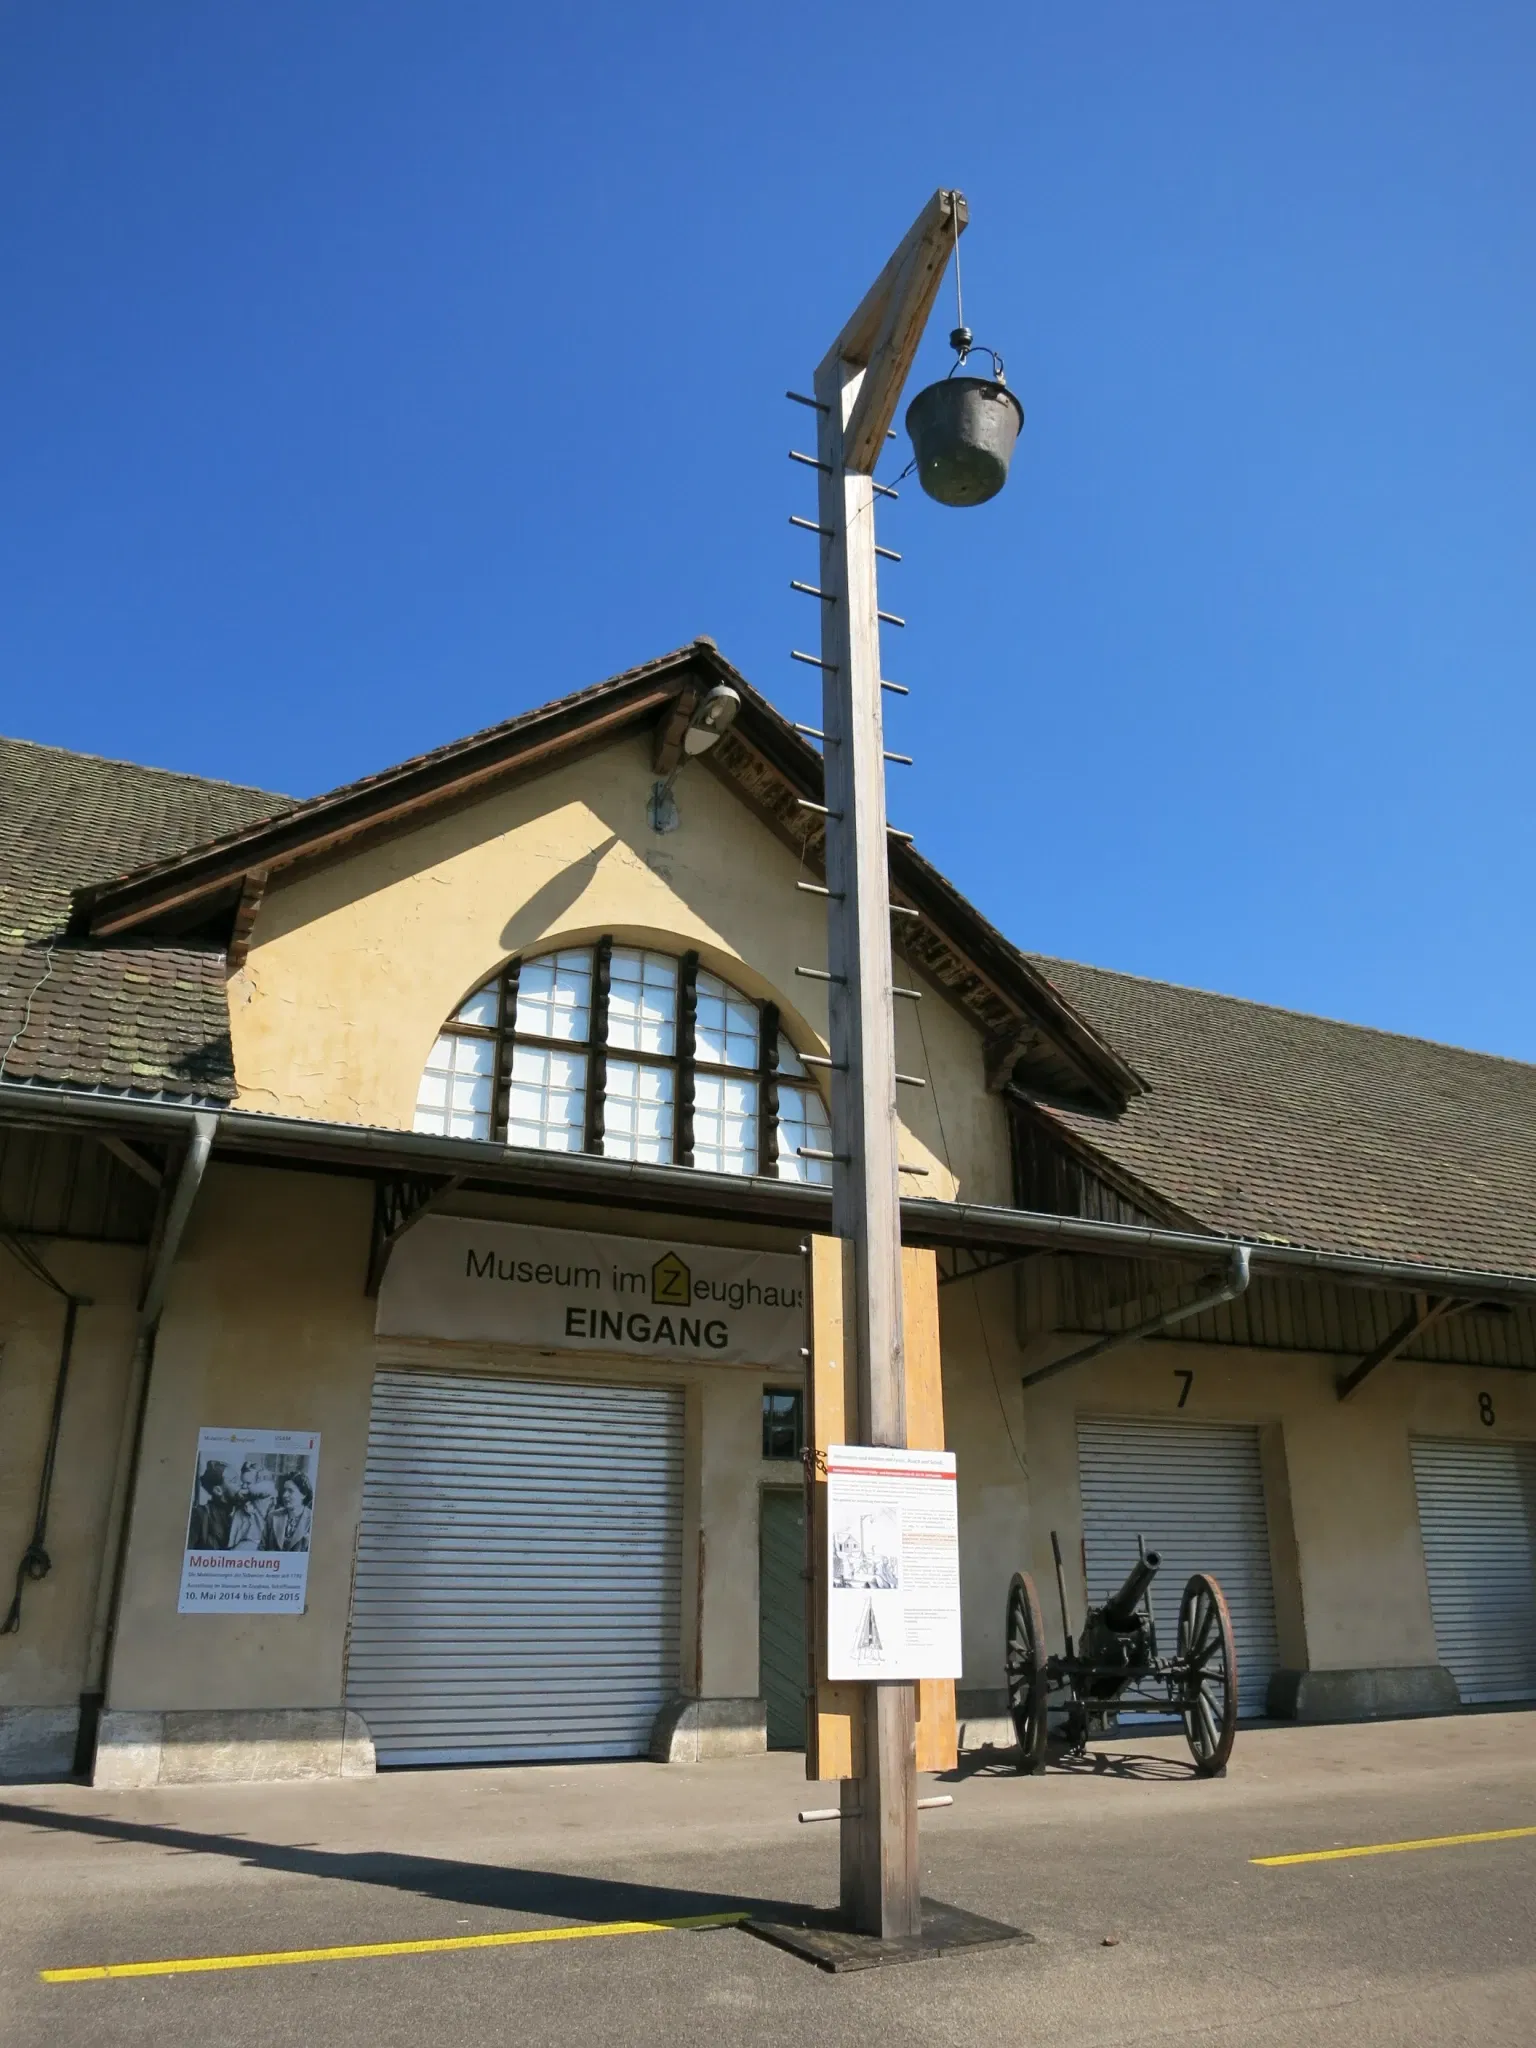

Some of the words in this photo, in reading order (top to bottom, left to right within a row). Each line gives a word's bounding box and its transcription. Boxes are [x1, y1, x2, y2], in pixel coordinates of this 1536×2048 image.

[465, 1249, 601, 1289] Museum
[612, 1264, 647, 1294] im
[564, 1306, 730, 1350] EINGANG
[1173, 1370, 1194, 1408] 7
[1478, 1391, 1496, 1426] 8
[189, 1555, 281, 1572] Mobilmachung
[185, 1591, 198, 1600] 10.
[200, 1592, 216, 1600] Mai
[219, 1591, 241, 1601] 2014
[243, 1592, 254, 1601] bis
[257, 1592, 276, 1601] Ende
[279, 1592, 300, 1601] 2015
